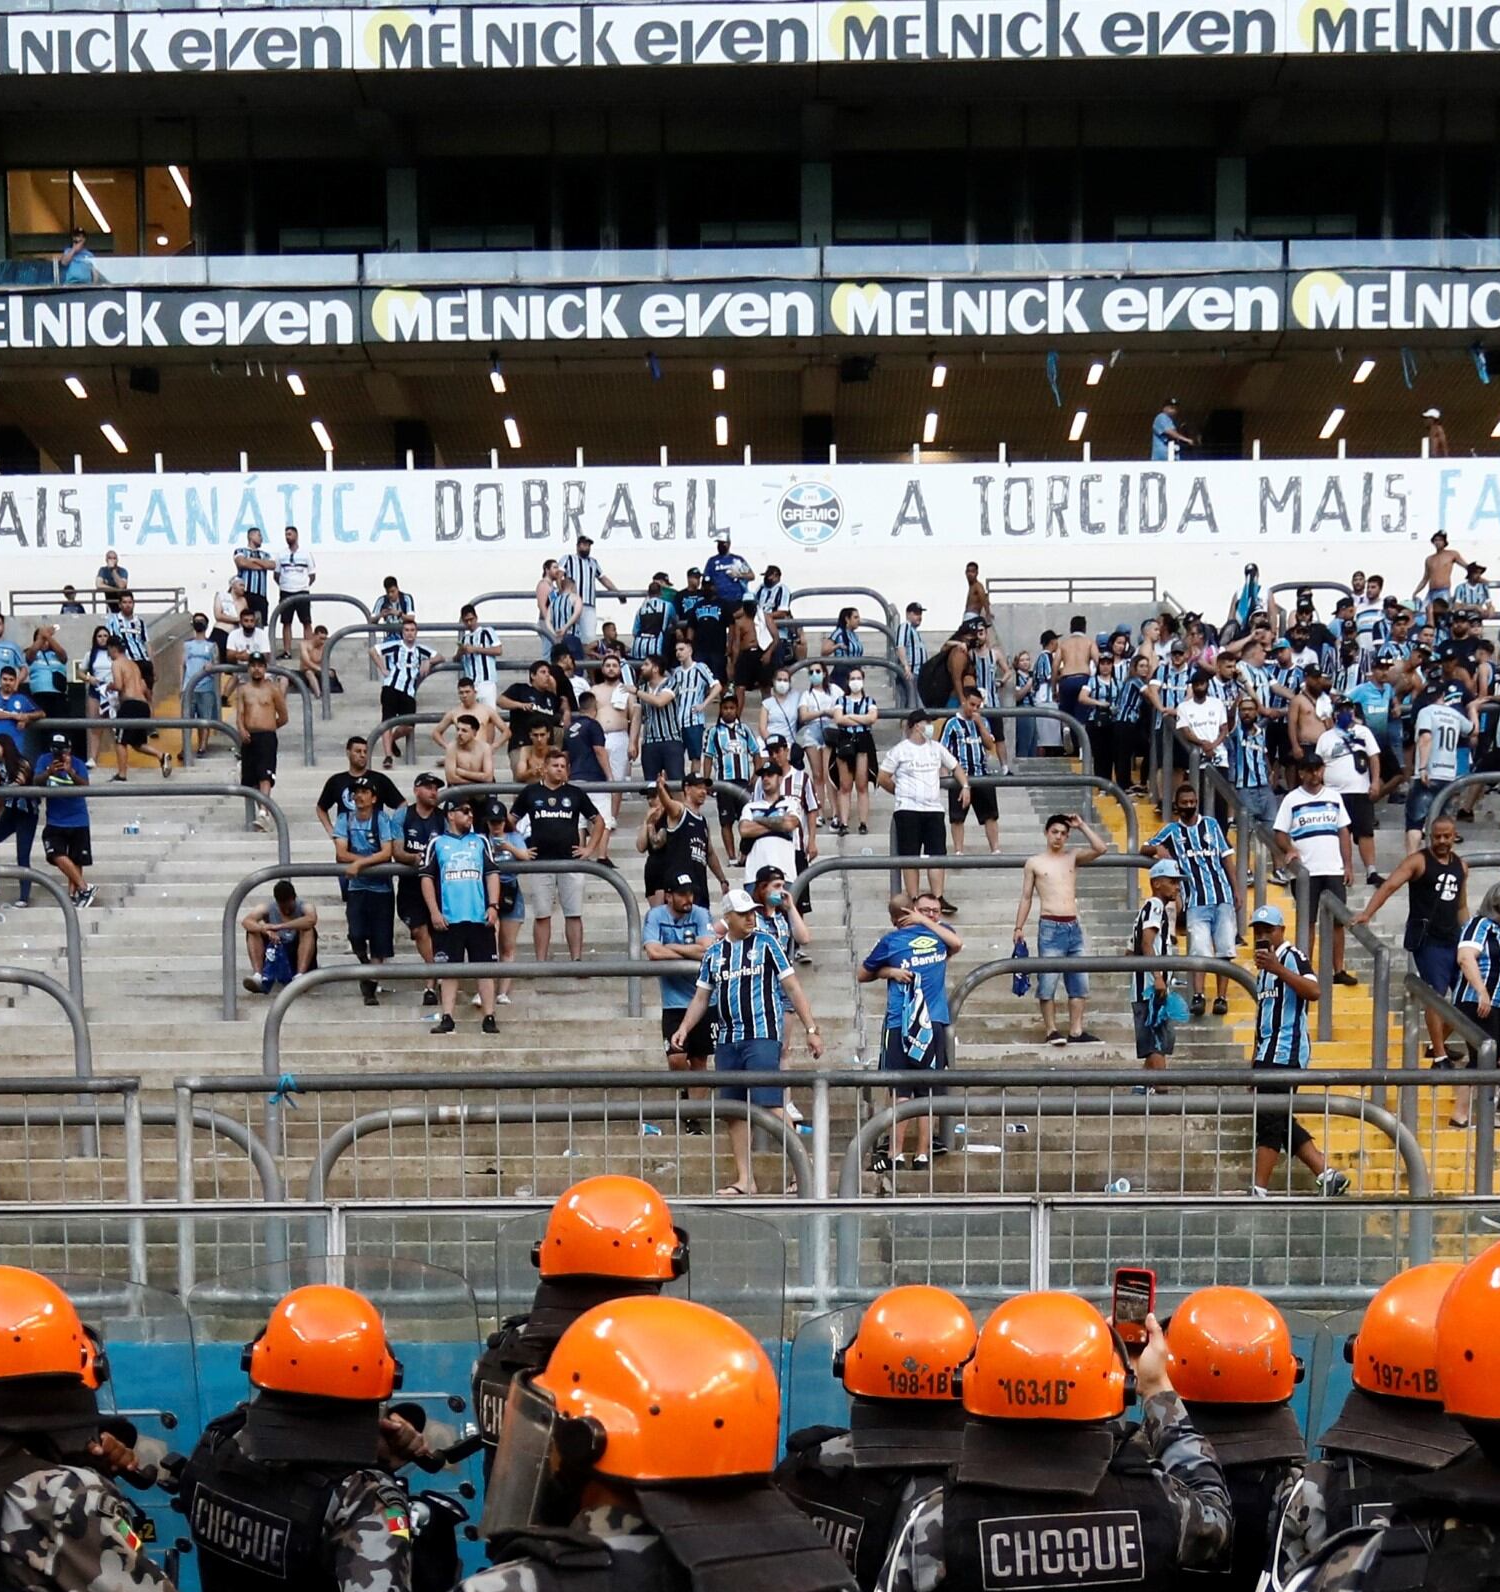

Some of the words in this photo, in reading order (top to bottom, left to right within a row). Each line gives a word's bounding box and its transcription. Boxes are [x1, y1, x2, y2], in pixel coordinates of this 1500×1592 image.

[169, 25, 341, 69] even
[636, 19, 807, 62] even
[1102, 12, 1275, 55] even
[180, 300, 353, 345] even
[640, 292, 814, 337] even
[1102, 283, 1279, 331] even
[107, 475, 411, 547] FANÁTICA
[523, 478, 730, 541] BRASIL
[782, 505, 840, 521] GRÊMIO
[892, 480, 933, 537] A
[973, 471, 1219, 537] TORCIDA
[1260, 472, 1407, 534] MAIS
[1438, 726, 1456, 752] 10
[541, 809, 573, 820] Banrisul
[1298, 812, 1337, 827] Banrisul
[887, 1371, 948, 1396] 198-1B
[1372, 1360, 1439, 1393] 197-1B
[196, 1501, 284, 1566] CHOQUE
[988, 1521, 1141, 1579] CHOQUE
